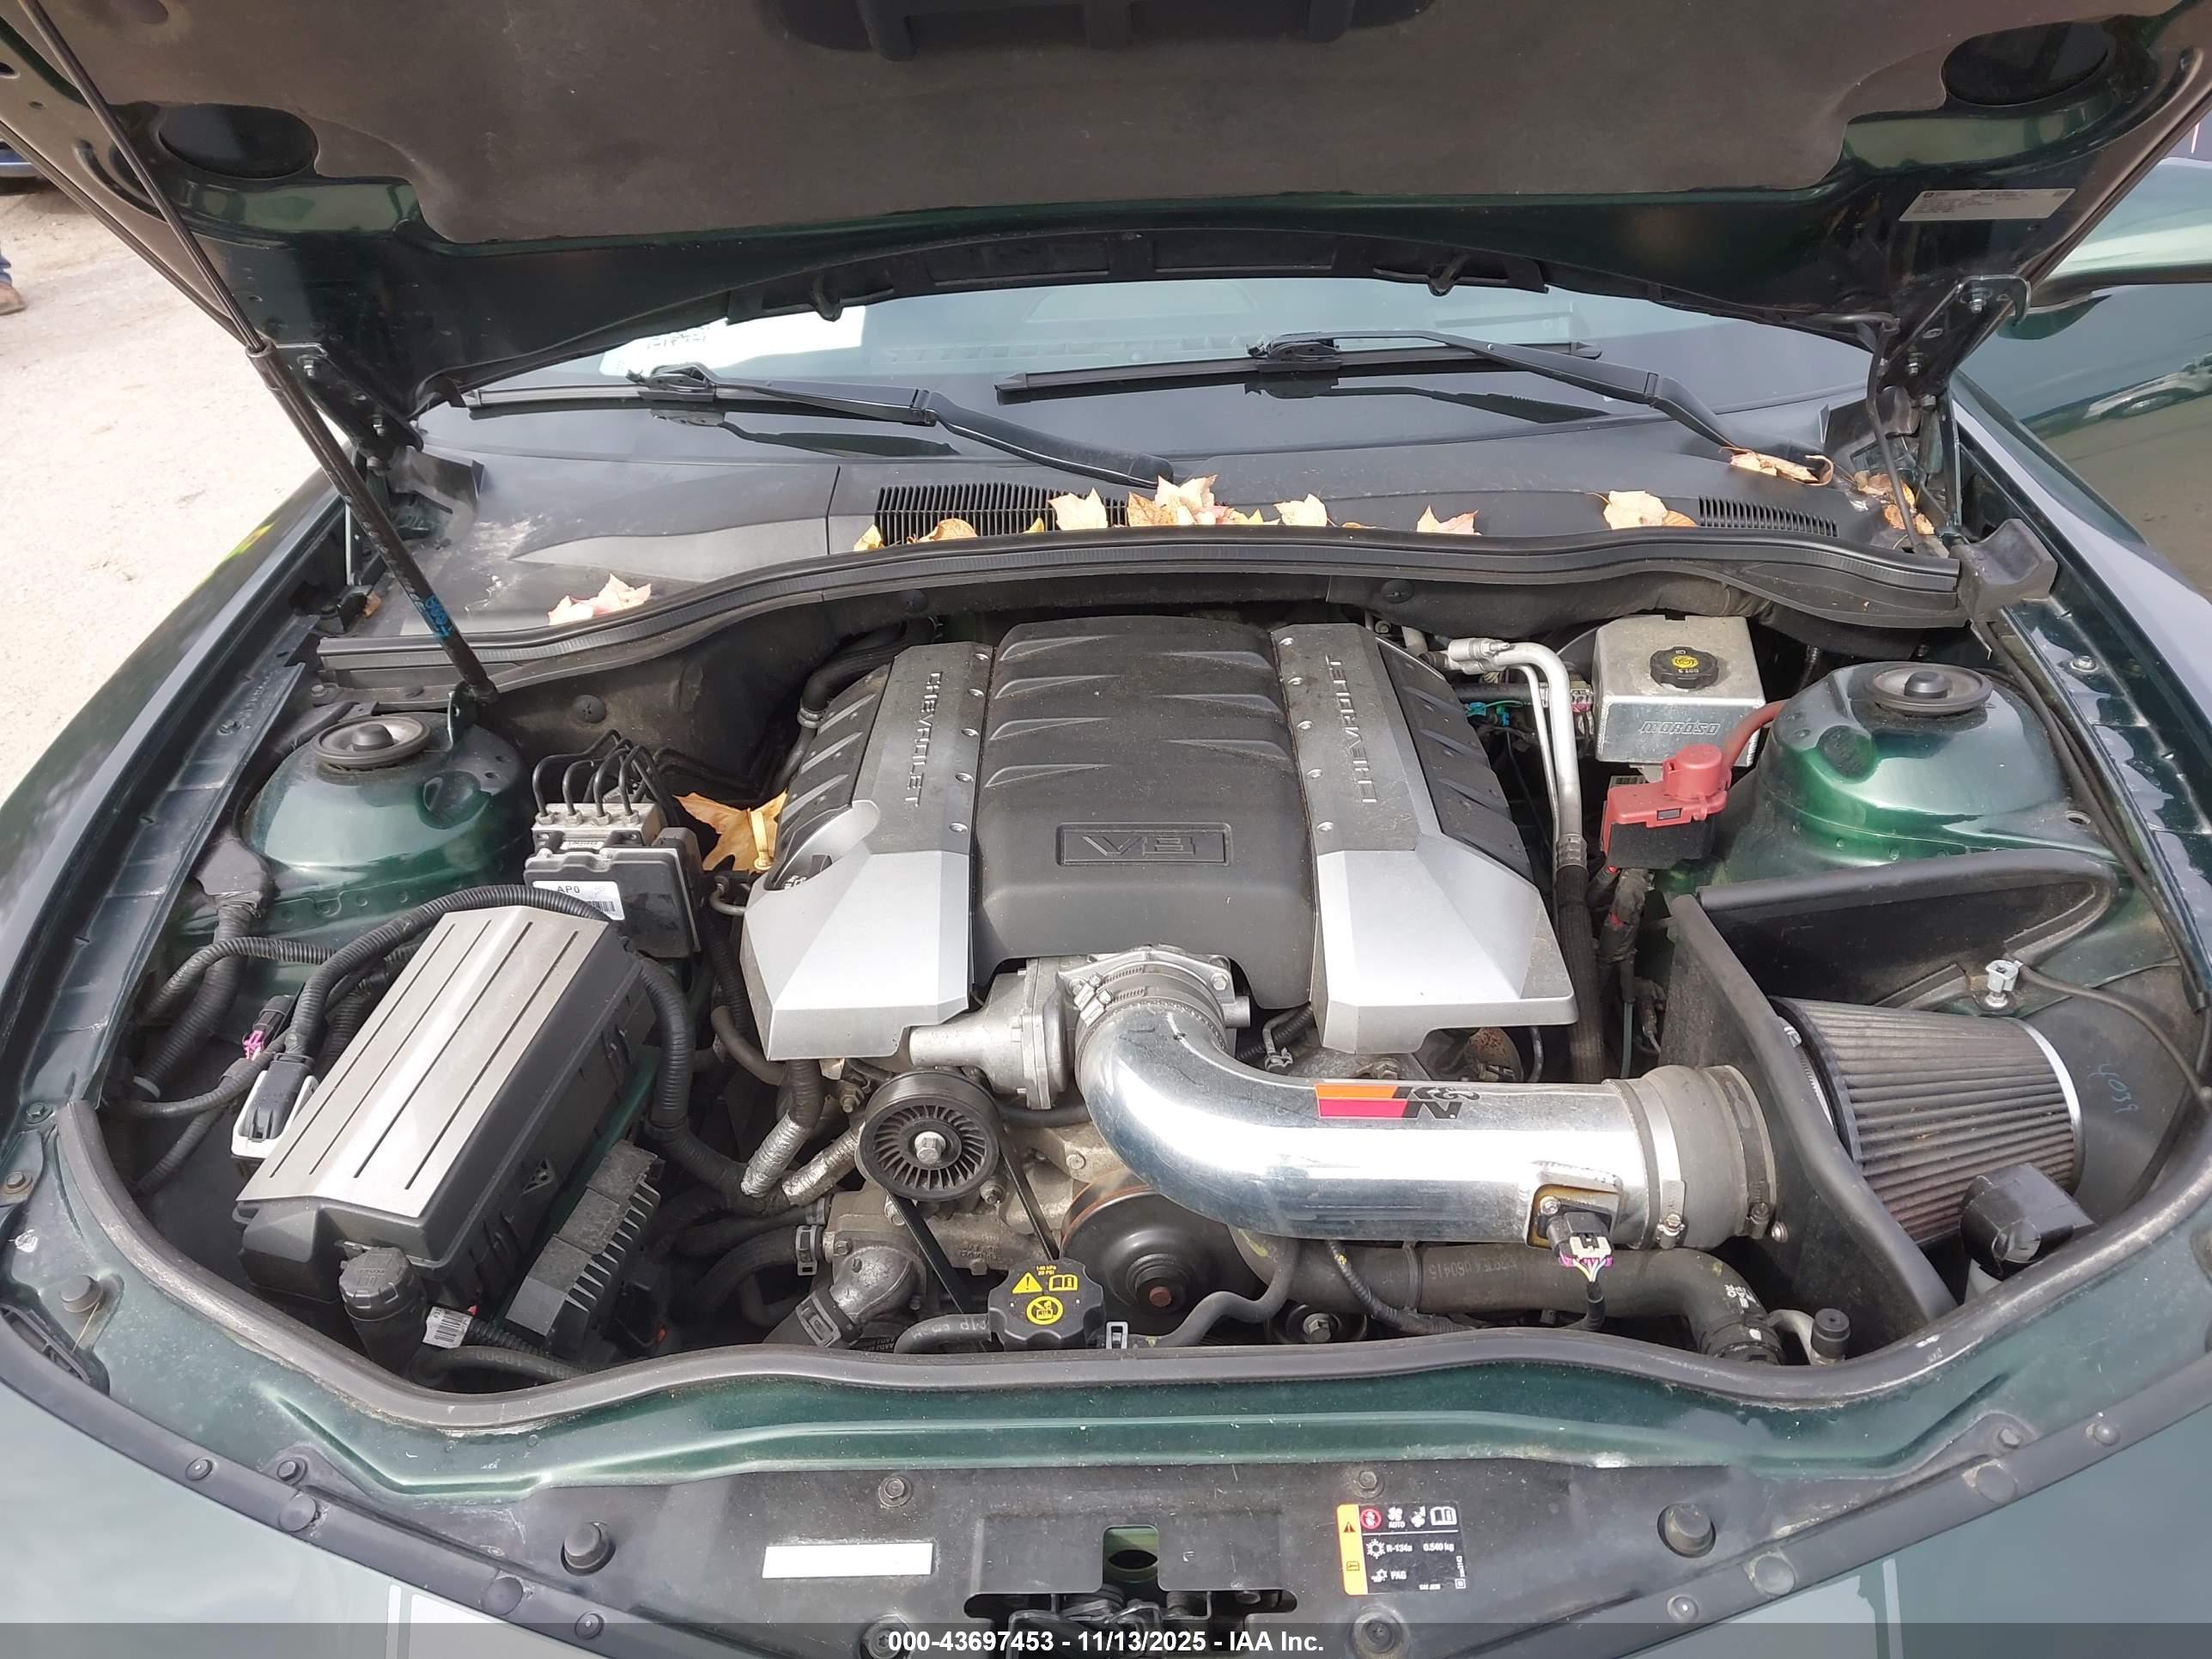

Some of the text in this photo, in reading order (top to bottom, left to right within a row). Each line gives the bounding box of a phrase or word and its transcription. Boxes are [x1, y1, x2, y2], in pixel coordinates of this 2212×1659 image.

[902, 670, 945, 809] CHEVROLET
[1325, 653, 1378, 805] CHEVROLET
[1082, 836, 1196, 858] V8
[1385, 1542, 1413, 1553] R-134a
[1443, 1540, 1455, 1553] kg
[1389, 1570, 1407, 1580] PAG
